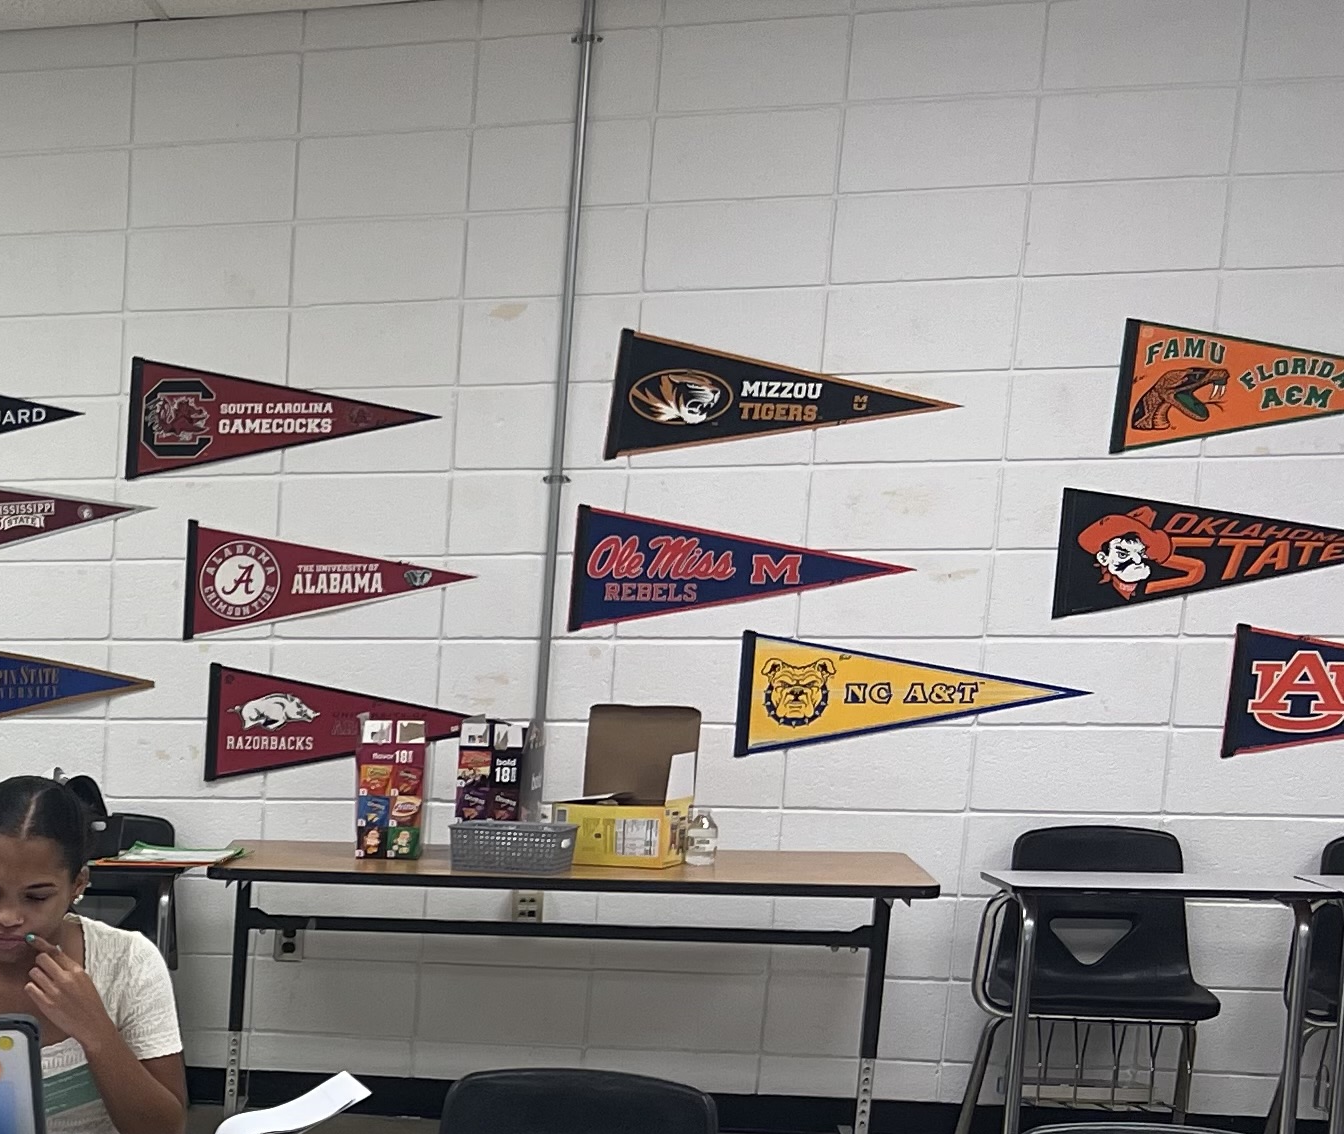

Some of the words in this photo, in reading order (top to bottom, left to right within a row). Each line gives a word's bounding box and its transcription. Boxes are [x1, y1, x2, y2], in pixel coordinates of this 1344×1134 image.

[1145, 337, 1227, 366] FAMU
[740, 380, 823, 399] MIZZOU
[219, 403, 263, 415] SOUTH
[266, 402, 333, 415] CAROLINA
[739, 402, 818, 422] TIGERS
[218, 418, 333, 434] GAMECOCKS
[5, 515, 39, 527] STATE
[205, 544, 276, 576] ALABAMA
[297, 564, 314, 573] THE
[316, 563, 368, 573] UNIVERSITY
[369, 563, 380, 571] OF
[587, 535, 645, 580] Ole
[648, 535, 736, 580] Miss
[750, 554, 802, 584] M
[1145, 537, 1344, 595] STATE
[291, 572, 383, 594] ALABAMA
[604, 582, 698, 602] REBELS
[204, 586, 250, 617] CRIMSON
[251, 585, 275, 610] TIDE
[20, 665, 59, 685] STATE
[844, 683, 893, 704] NC
[904, 682, 979, 704] A&T
[226, 735, 313, 751] RAZORBACKS
